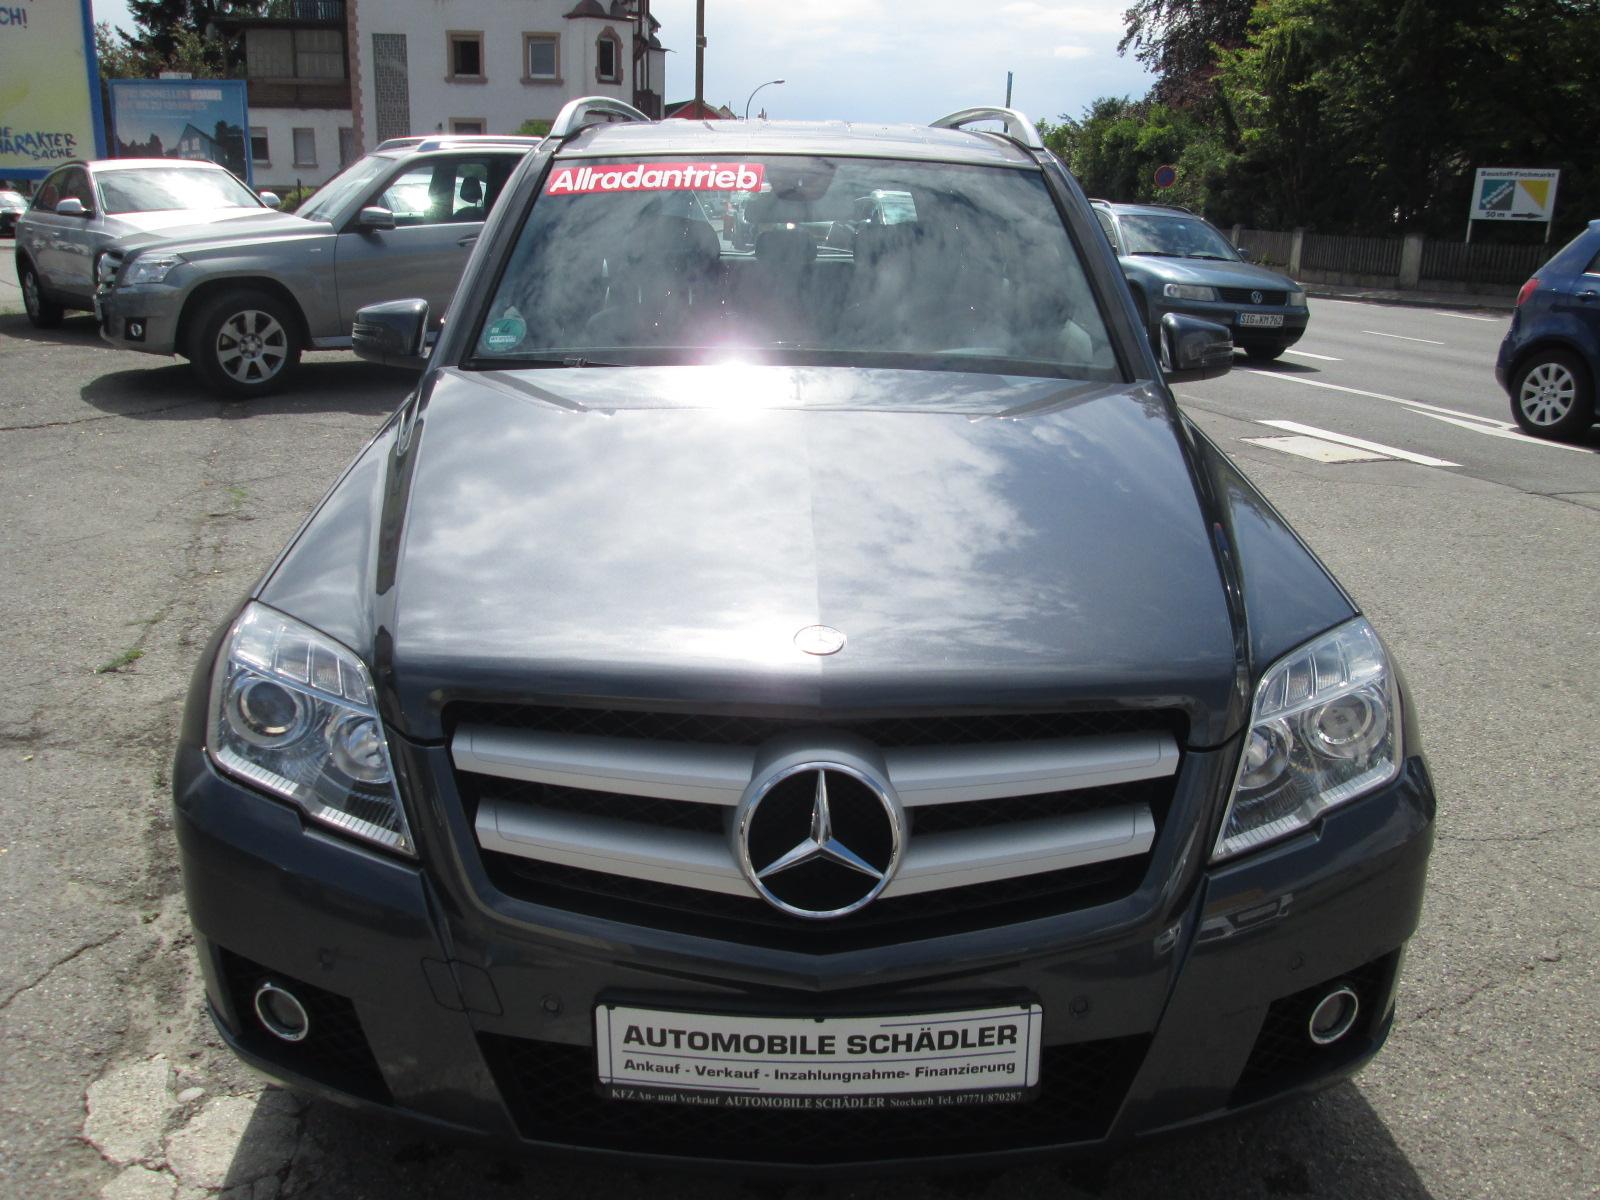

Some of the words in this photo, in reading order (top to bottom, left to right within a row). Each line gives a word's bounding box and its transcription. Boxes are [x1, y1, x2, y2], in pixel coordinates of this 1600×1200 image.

[31, 148, 76, 160] SACHE
[549, 164, 758, 192] Allradantrieb
[622, 1024, 835, 1055] AUTOMOBILE
[847, 1024, 1018, 1054] SCHÄDLER
[624, 1059, 680, 1074] Ankauf
[694, 1065, 760, 1079] Verkauf
[915, 1062, 1016, 1078] Finanzierung
[611, 1088, 635, 1100] KFZ
[658, 1093, 677, 1103] und
[679, 1093, 719, 1105] Verkauf
[725, 1095, 812, 1109] AUTOMOBILE
[815, 1095, 885, 1109] SCHÄDLER
[890, 1096, 934, 1107] Stockach
[937, 1094, 954, 1105] Tel.
